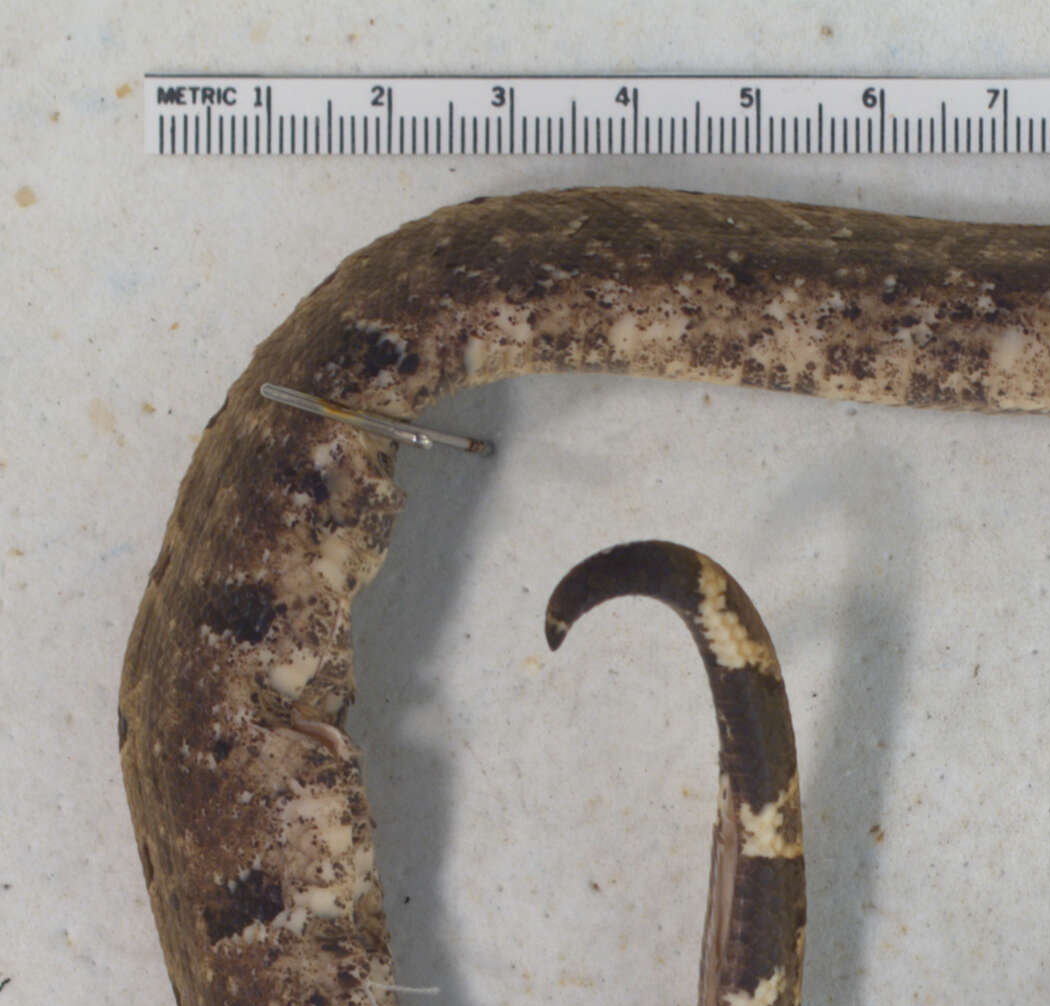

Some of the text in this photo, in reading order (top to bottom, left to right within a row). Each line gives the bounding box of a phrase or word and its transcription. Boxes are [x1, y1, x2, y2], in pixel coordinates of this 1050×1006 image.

[157, 86, 237, 106] METRIC
[254, 86, 263, 107] 1
[371, 85, 385, 107] 2
[491, 86, 506, 108] 3
[615, 86, 631, 107] 4
[740, 87, 754, 109] 5
[862, 87, 878, 109] 6
[987, 88, 1000, 109] 7
